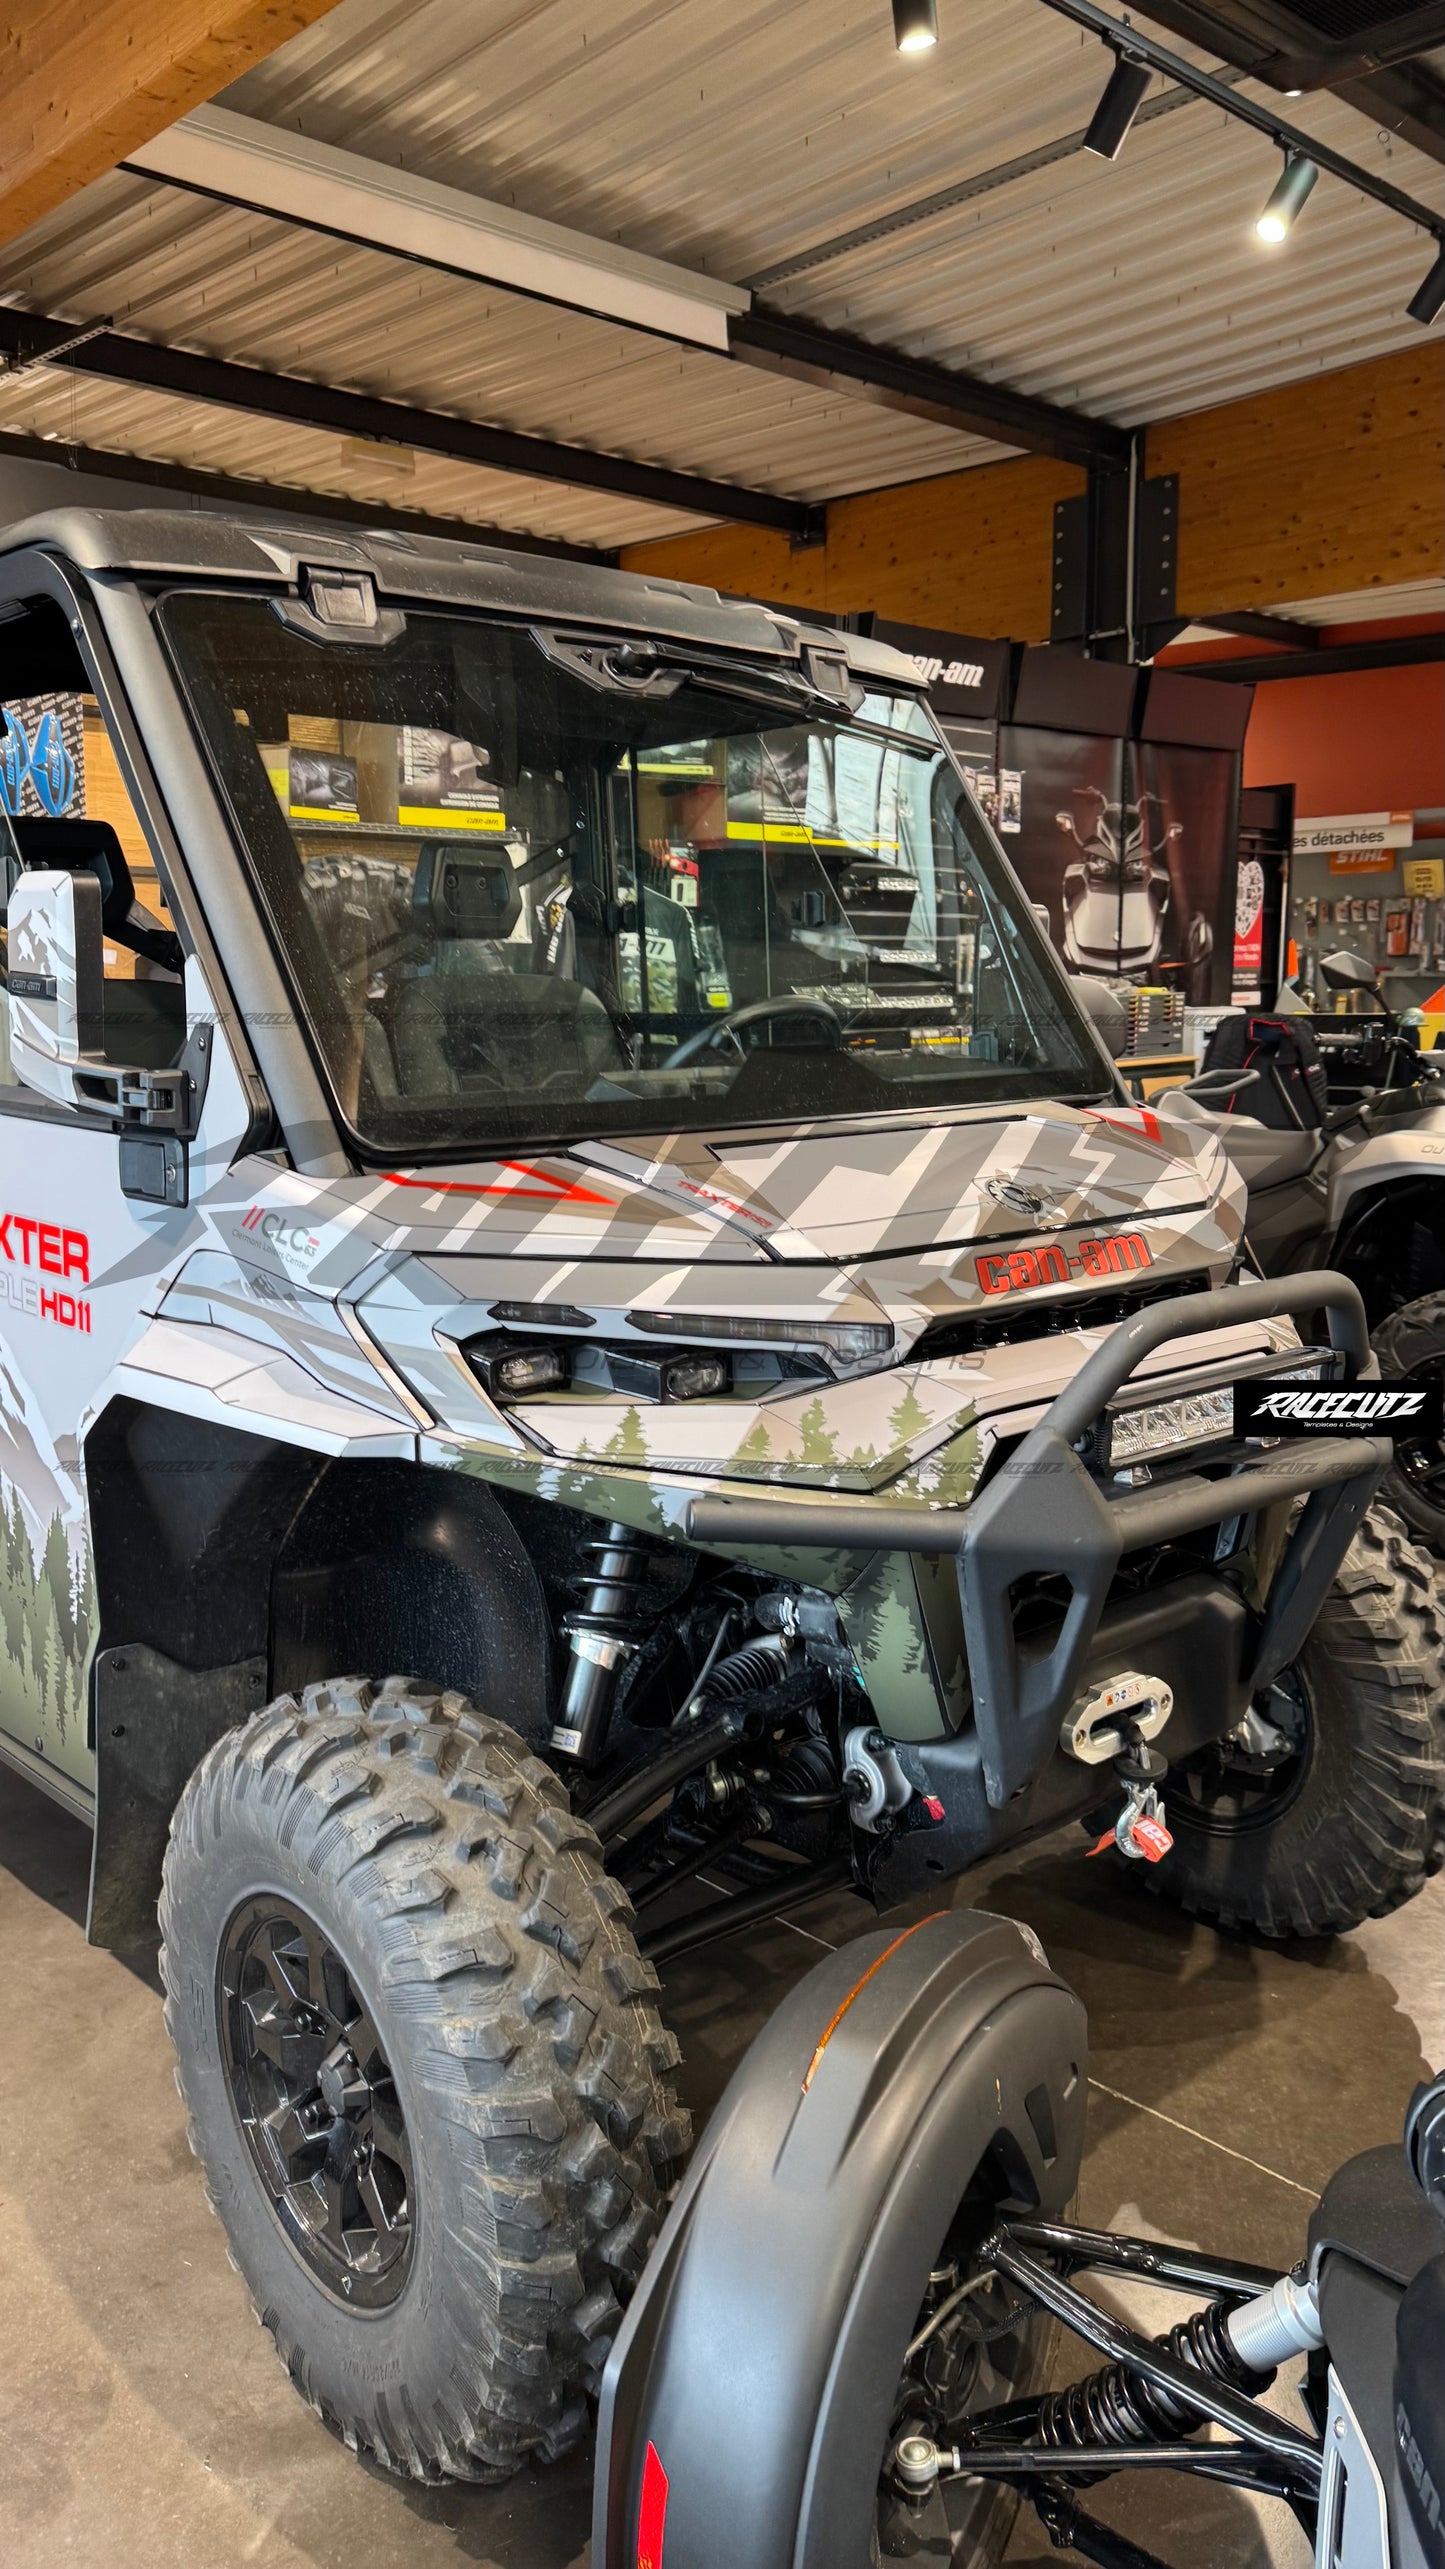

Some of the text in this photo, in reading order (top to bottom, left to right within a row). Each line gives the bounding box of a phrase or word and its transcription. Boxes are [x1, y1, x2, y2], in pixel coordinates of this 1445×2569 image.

[1311, 830, 1385, 846] détachées
[1336, 848, 1388, 864] STIHL
[975, 1232, 1155, 1296] can-am
[40, 1286, 92, 1335] HD11
